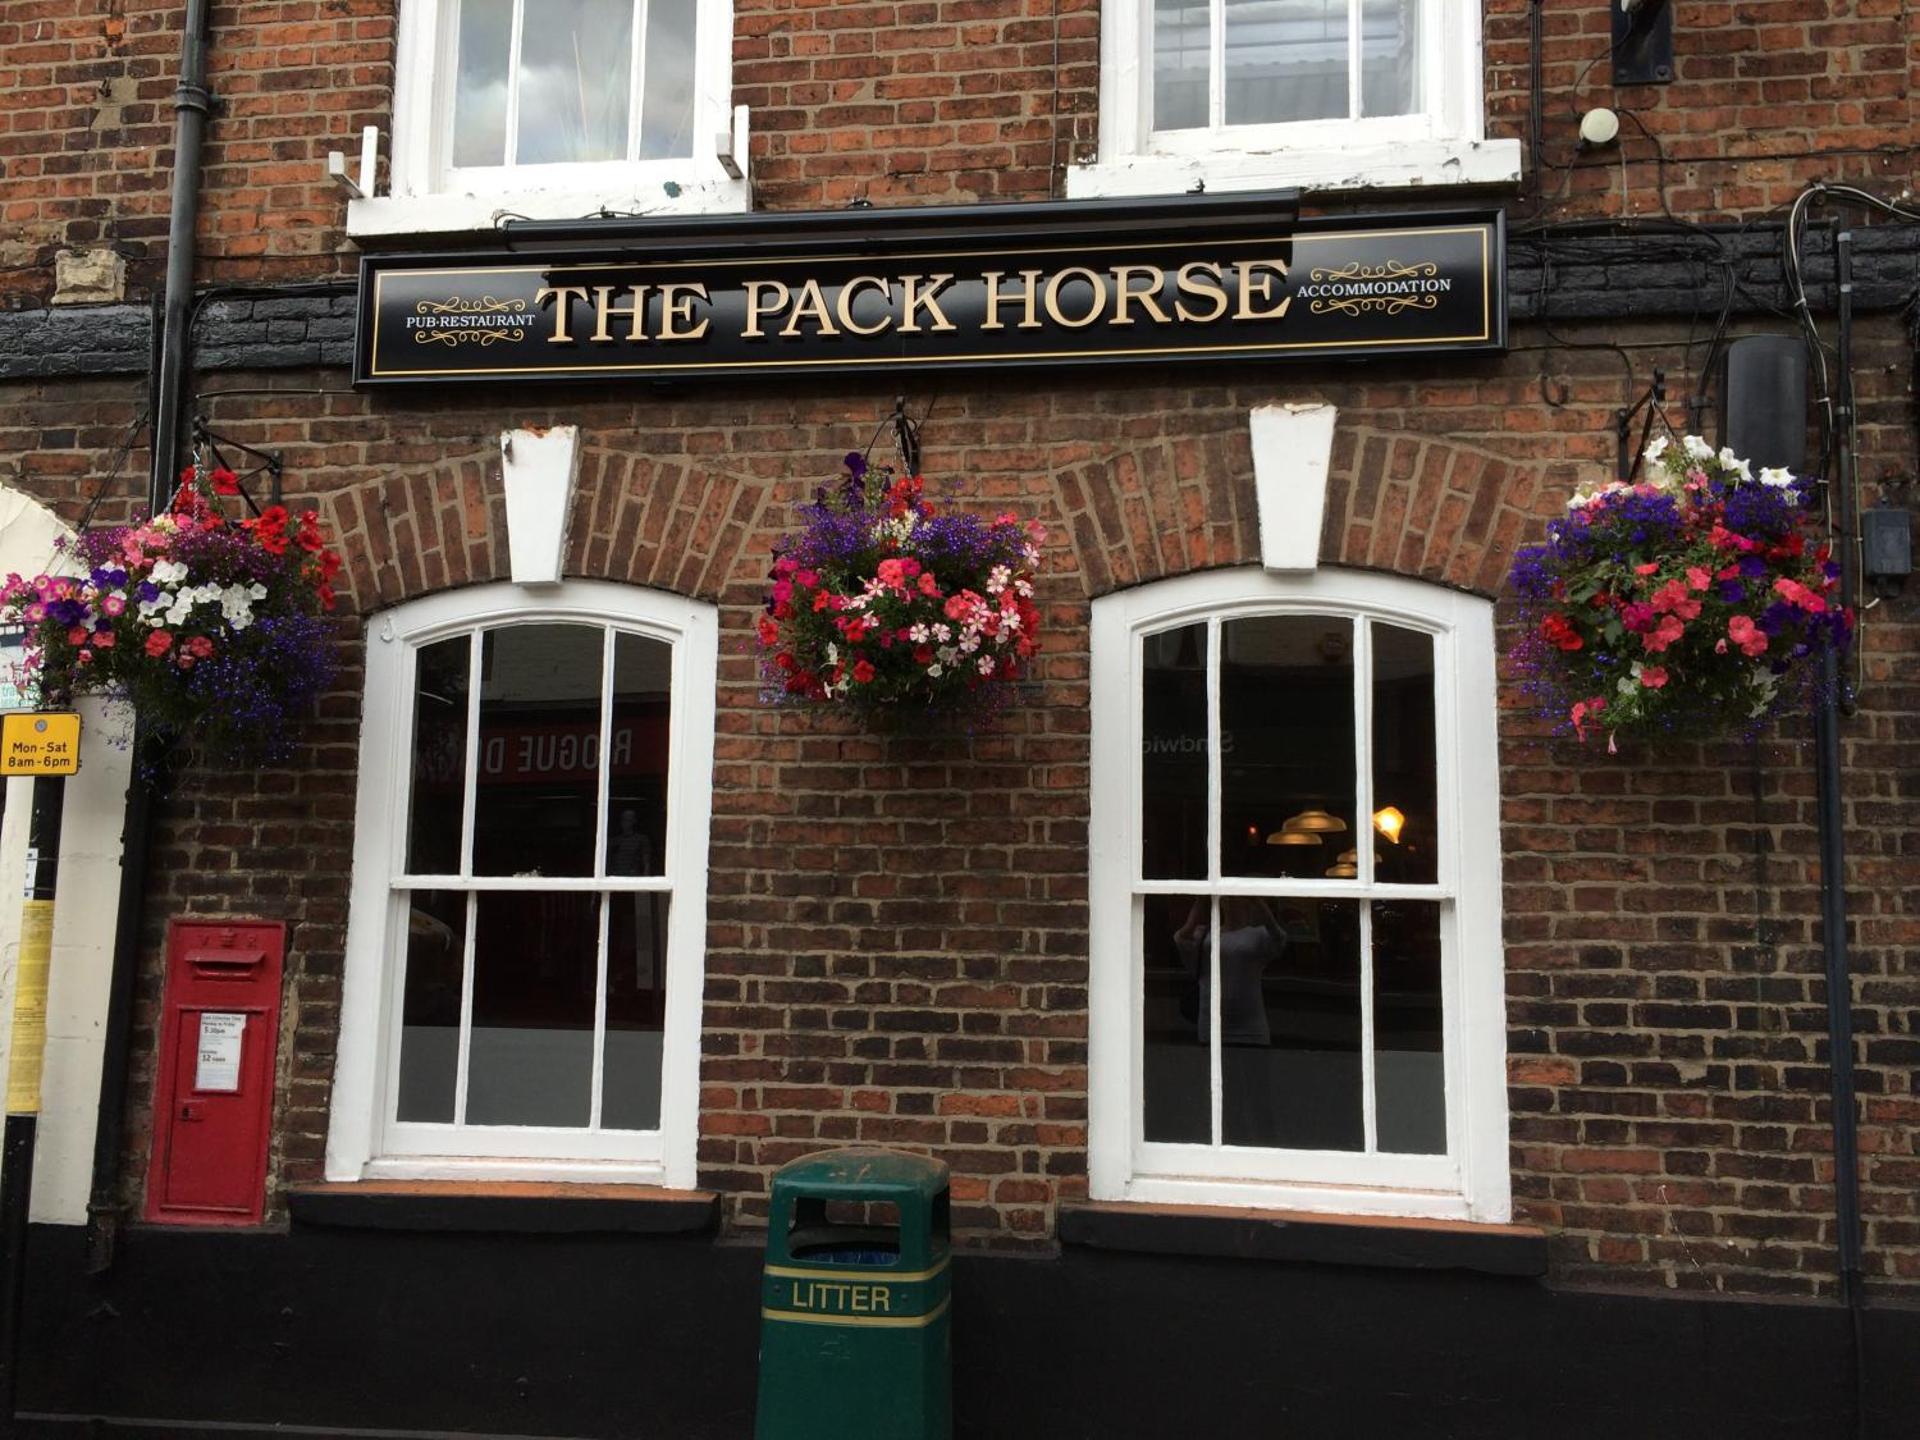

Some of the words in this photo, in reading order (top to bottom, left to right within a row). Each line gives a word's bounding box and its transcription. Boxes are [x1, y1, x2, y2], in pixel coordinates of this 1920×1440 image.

[534, 281, 711, 343] THE
[741, 273, 957, 337] PACK
[980, 258, 1292, 330] HORSE
[1297, 277, 1452, 298] ACCOMMODATION
[793, 1281, 891, 1312] LITTER
